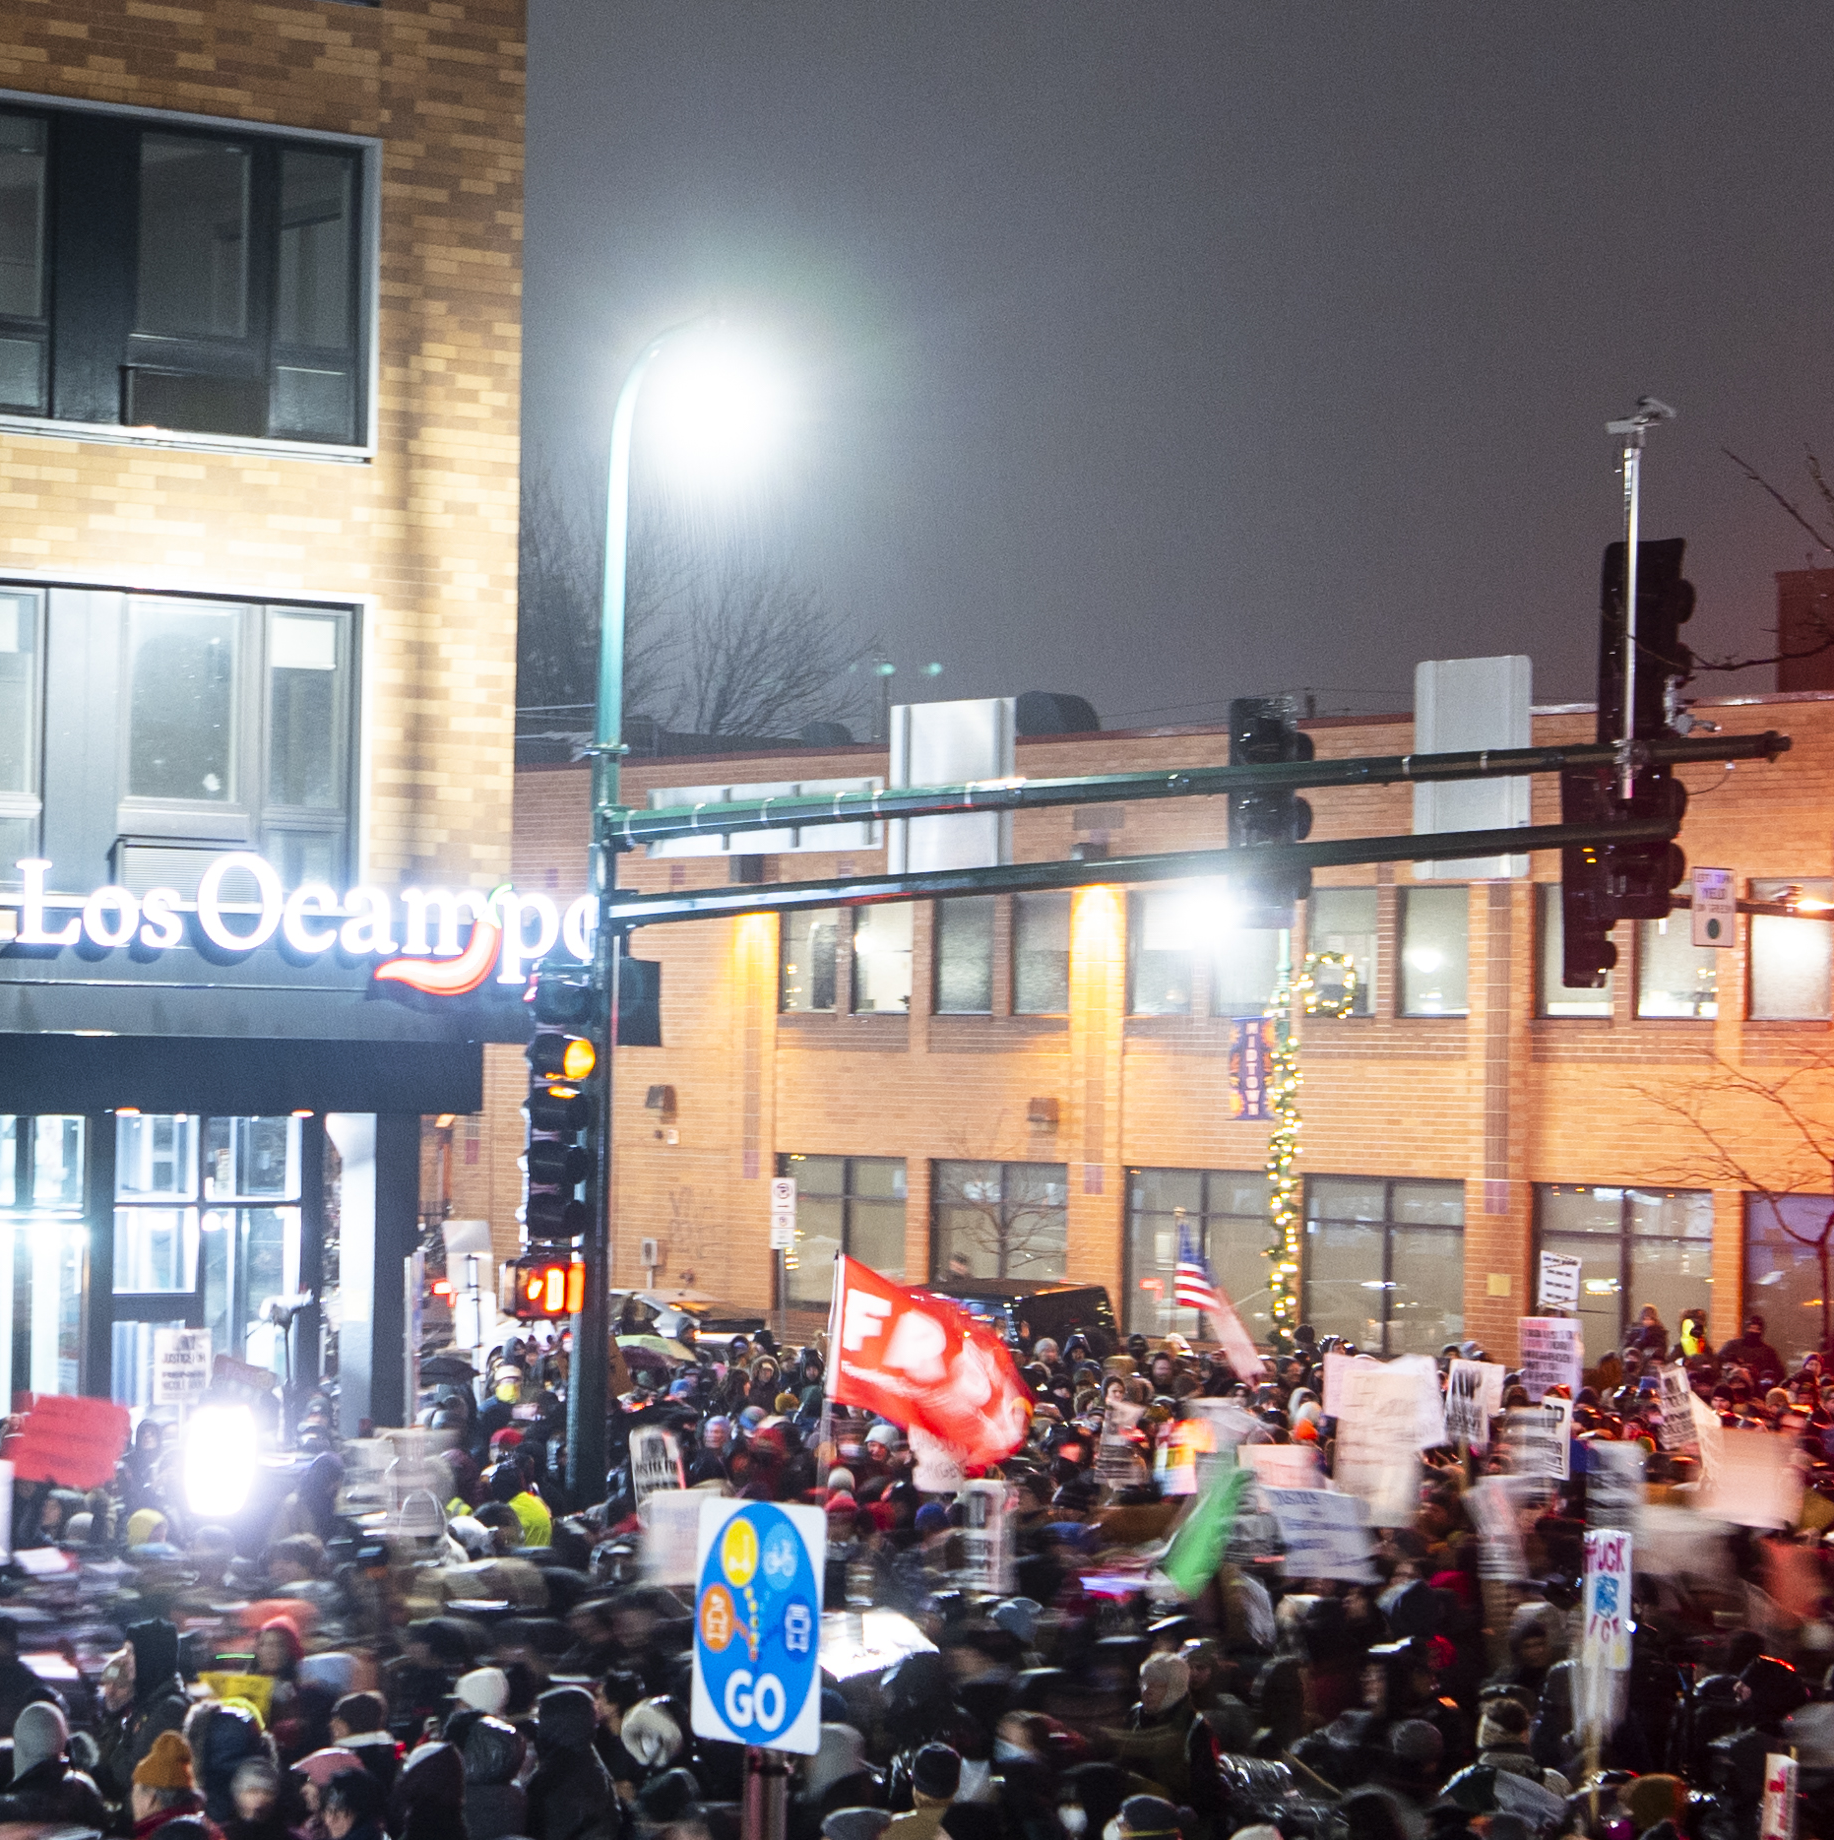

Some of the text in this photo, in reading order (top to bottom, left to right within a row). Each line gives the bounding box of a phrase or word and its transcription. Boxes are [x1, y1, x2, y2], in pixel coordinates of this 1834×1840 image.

[15, 859, 185, 948] Los
[1244, 1022, 1261, 1116] MIDTOWN
[724, 1668, 787, 1732] GO
